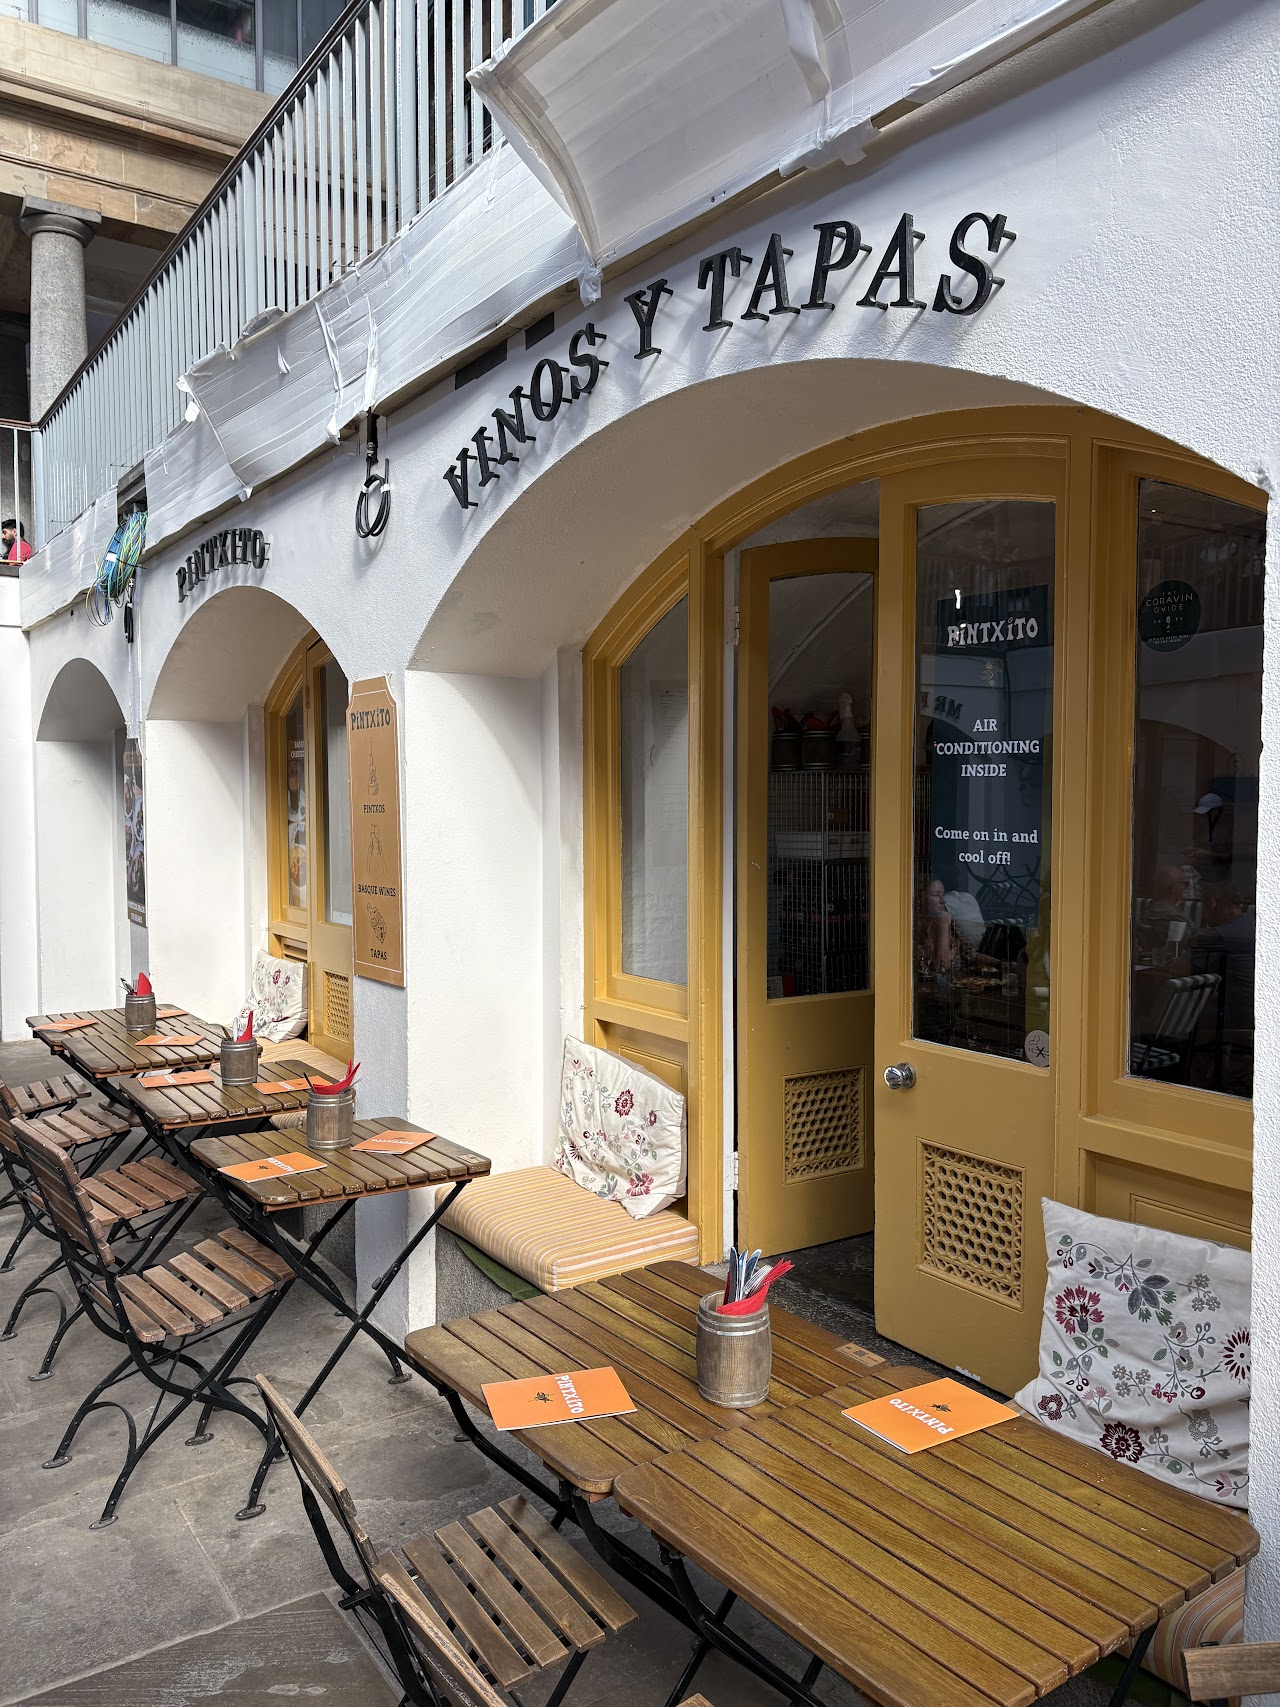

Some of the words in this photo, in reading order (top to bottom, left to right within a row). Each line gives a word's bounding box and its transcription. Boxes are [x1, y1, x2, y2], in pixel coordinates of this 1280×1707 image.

[443, 323, 603, 508] VINOS
[624, 279, 670, 359] Y
[698, 212, 1010, 331] TAPAS
[176, 528, 266, 603] PINTXITO
[1146, 593, 1193, 606] CORAVIN
[973, 719, 998, 732] AIR
[936, 740, 1040, 755] CONDITIONING
[961, 764, 1007, 777] INSIDE
[363, 804, 386, 814] PINTXOS
[935, 826, 970, 840] Come
[973, 831, 989, 841] on
[993, 828, 1008, 842] in
[1012, 829, 1039, 843] and
[958, 850, 985, 863] cool
[988, 851, 1011, 866] off!
[358, 884, 378, 896] BASQUE
[379, 886, 396, 897] WINES
[370, 948, 387, 960] TAPAS
